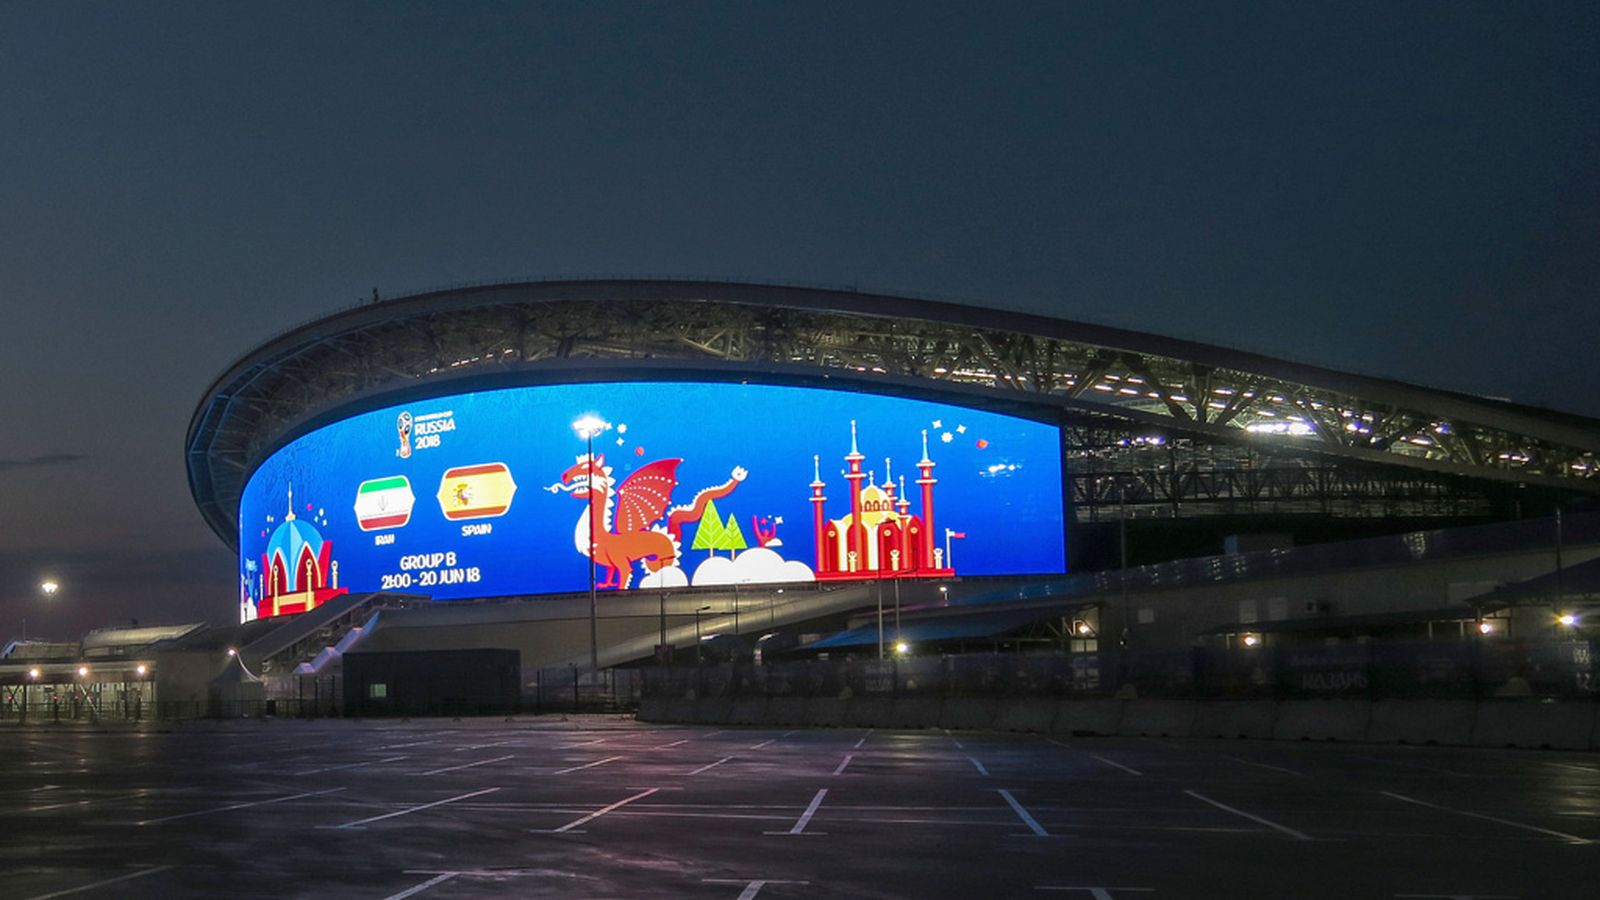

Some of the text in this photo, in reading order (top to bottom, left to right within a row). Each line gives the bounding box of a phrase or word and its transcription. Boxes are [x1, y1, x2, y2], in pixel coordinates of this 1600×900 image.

[415, 418, 456, 436] RUSSIA
[415, 433, 441, 449] 2018
[461, 523, 492, 537] SPAIN
[375, 534, 395, 546] IRAN
[400, 551, 456, 570] GROUP B
[381, 573, 411, 590] 21:00
[419, 571, 437, 586] 20
[439, 568, 464, 585] JUN
[466, 567, 481, 582] 18
